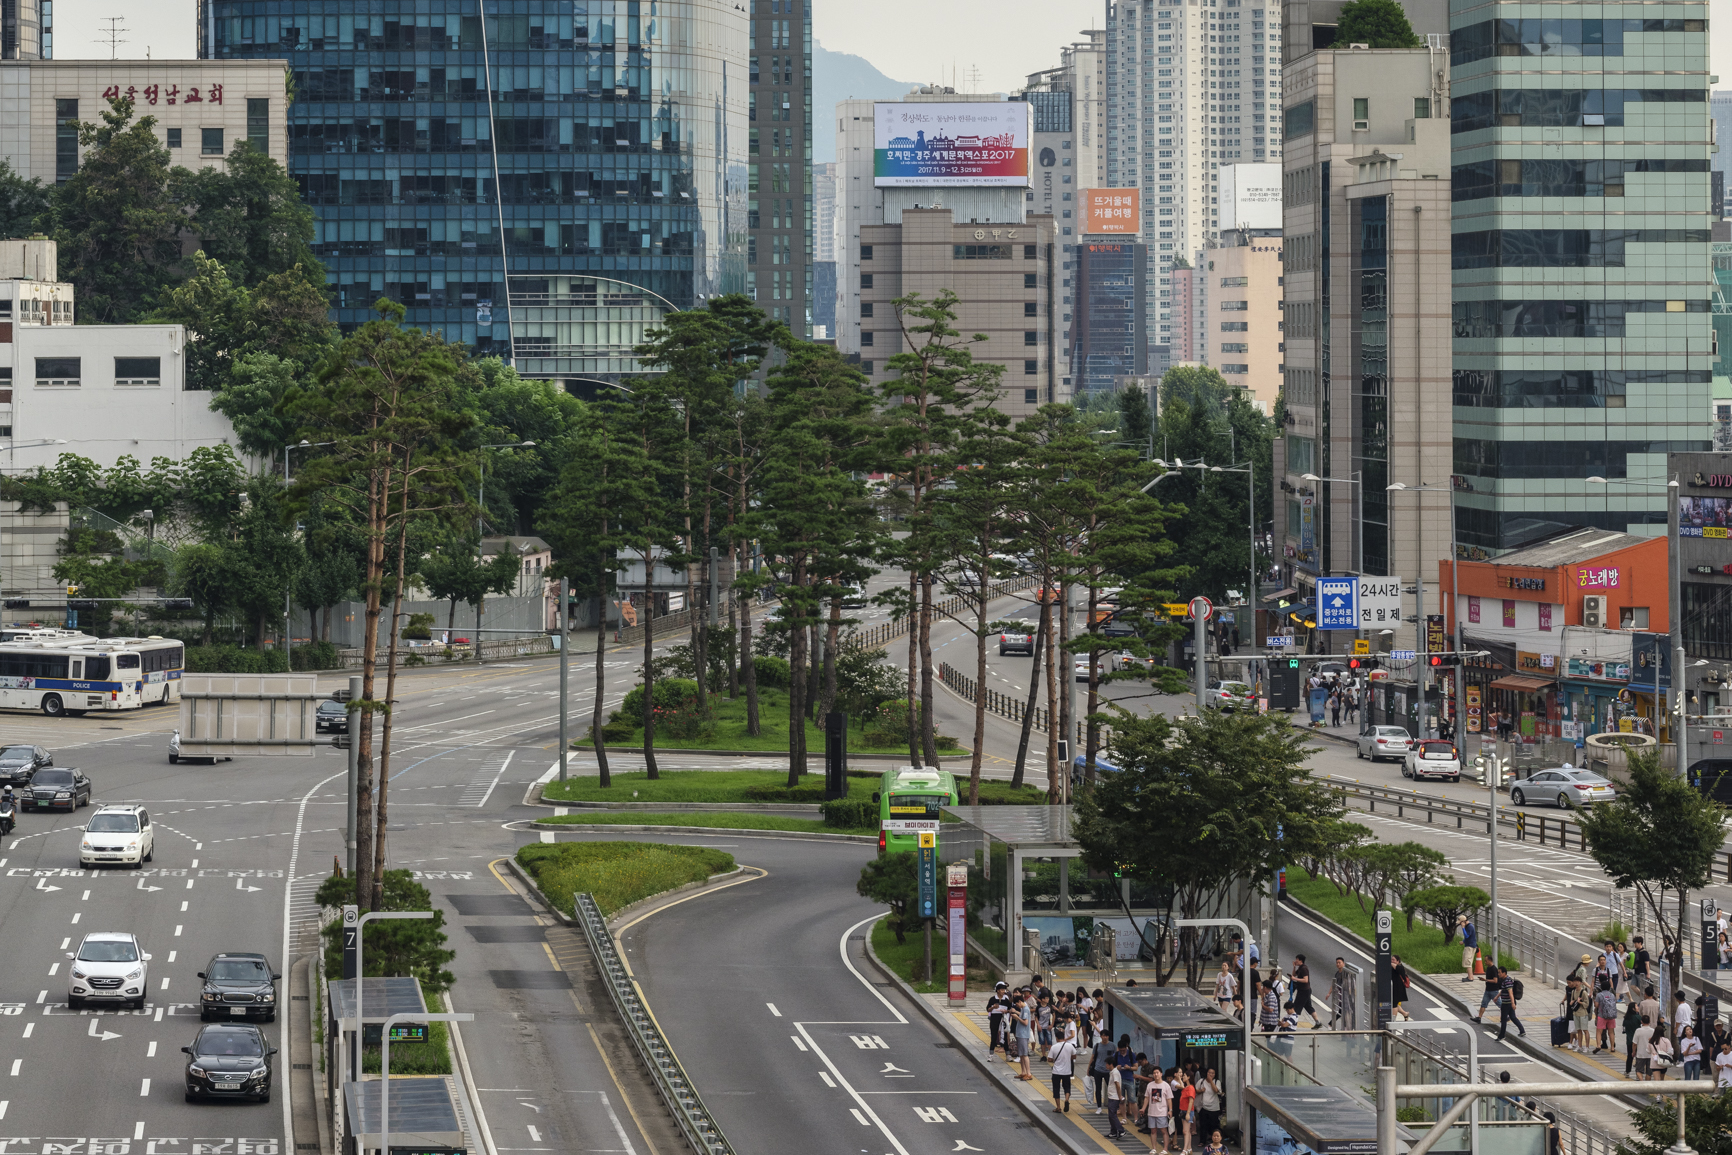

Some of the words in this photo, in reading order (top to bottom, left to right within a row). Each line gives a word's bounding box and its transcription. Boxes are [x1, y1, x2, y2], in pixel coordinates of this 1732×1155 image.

[102, 83, 223, 106] 서울성남교회
[1044, 171, 1052, 202] HOTEL
[1094, 196, 1132, 206] 뜨거울때
[1094, 208, 1132, 219] 커플여행
[1709, 474, 1732, 487] DVD
[1578, 569, 1618, 587] 궁노래방
[1361, 583, 1399, 597] 24시간
[1324, 608, 1352, 616] 중앙차로
[1324, 617, 1352, 625] 버스전용
[1267, 636, 1292, 645] 버스전용
[346, 932, 356, 946] 7
[1706, 926, 1715, 939] 5
[1380, 937, 1390, 951] 6
